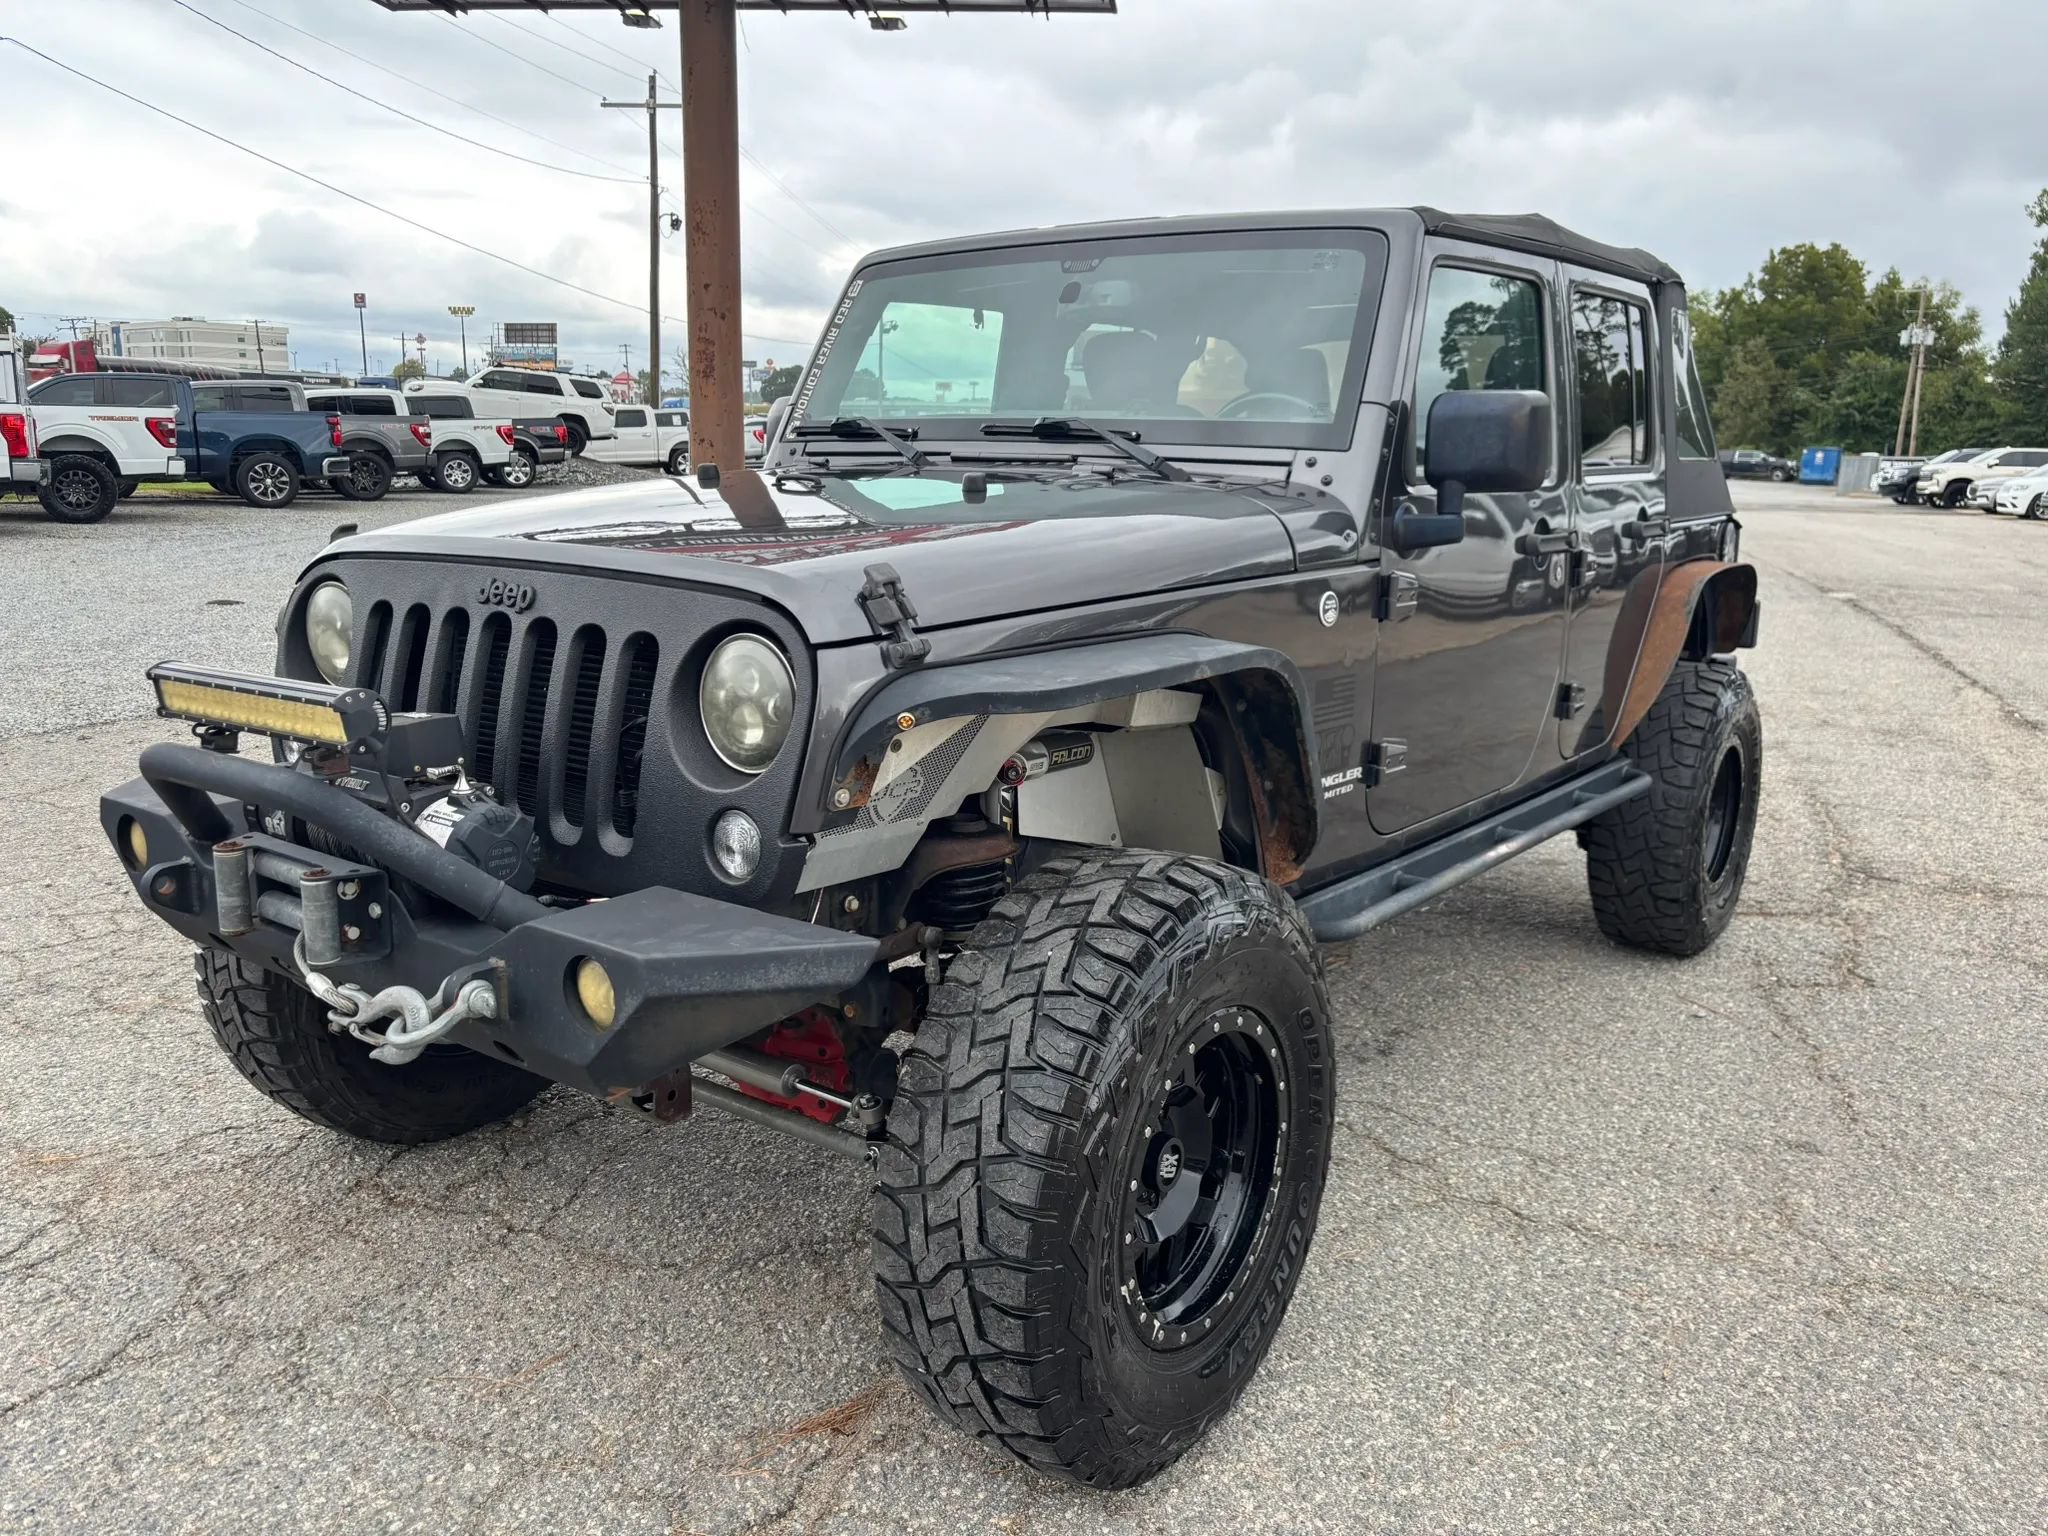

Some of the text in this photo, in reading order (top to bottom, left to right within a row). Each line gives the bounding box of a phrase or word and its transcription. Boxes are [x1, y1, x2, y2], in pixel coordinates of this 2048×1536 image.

[834, 299, 853, 325] RED
[816, 326, 840, 366] RIVER
[793, 368, 822, 419] EDITION
[478, 578, 536, 614] Jeep
[1051, 745, 1091, 765] FALCON
[1296, 1006, 1329, 1128] OPEN
